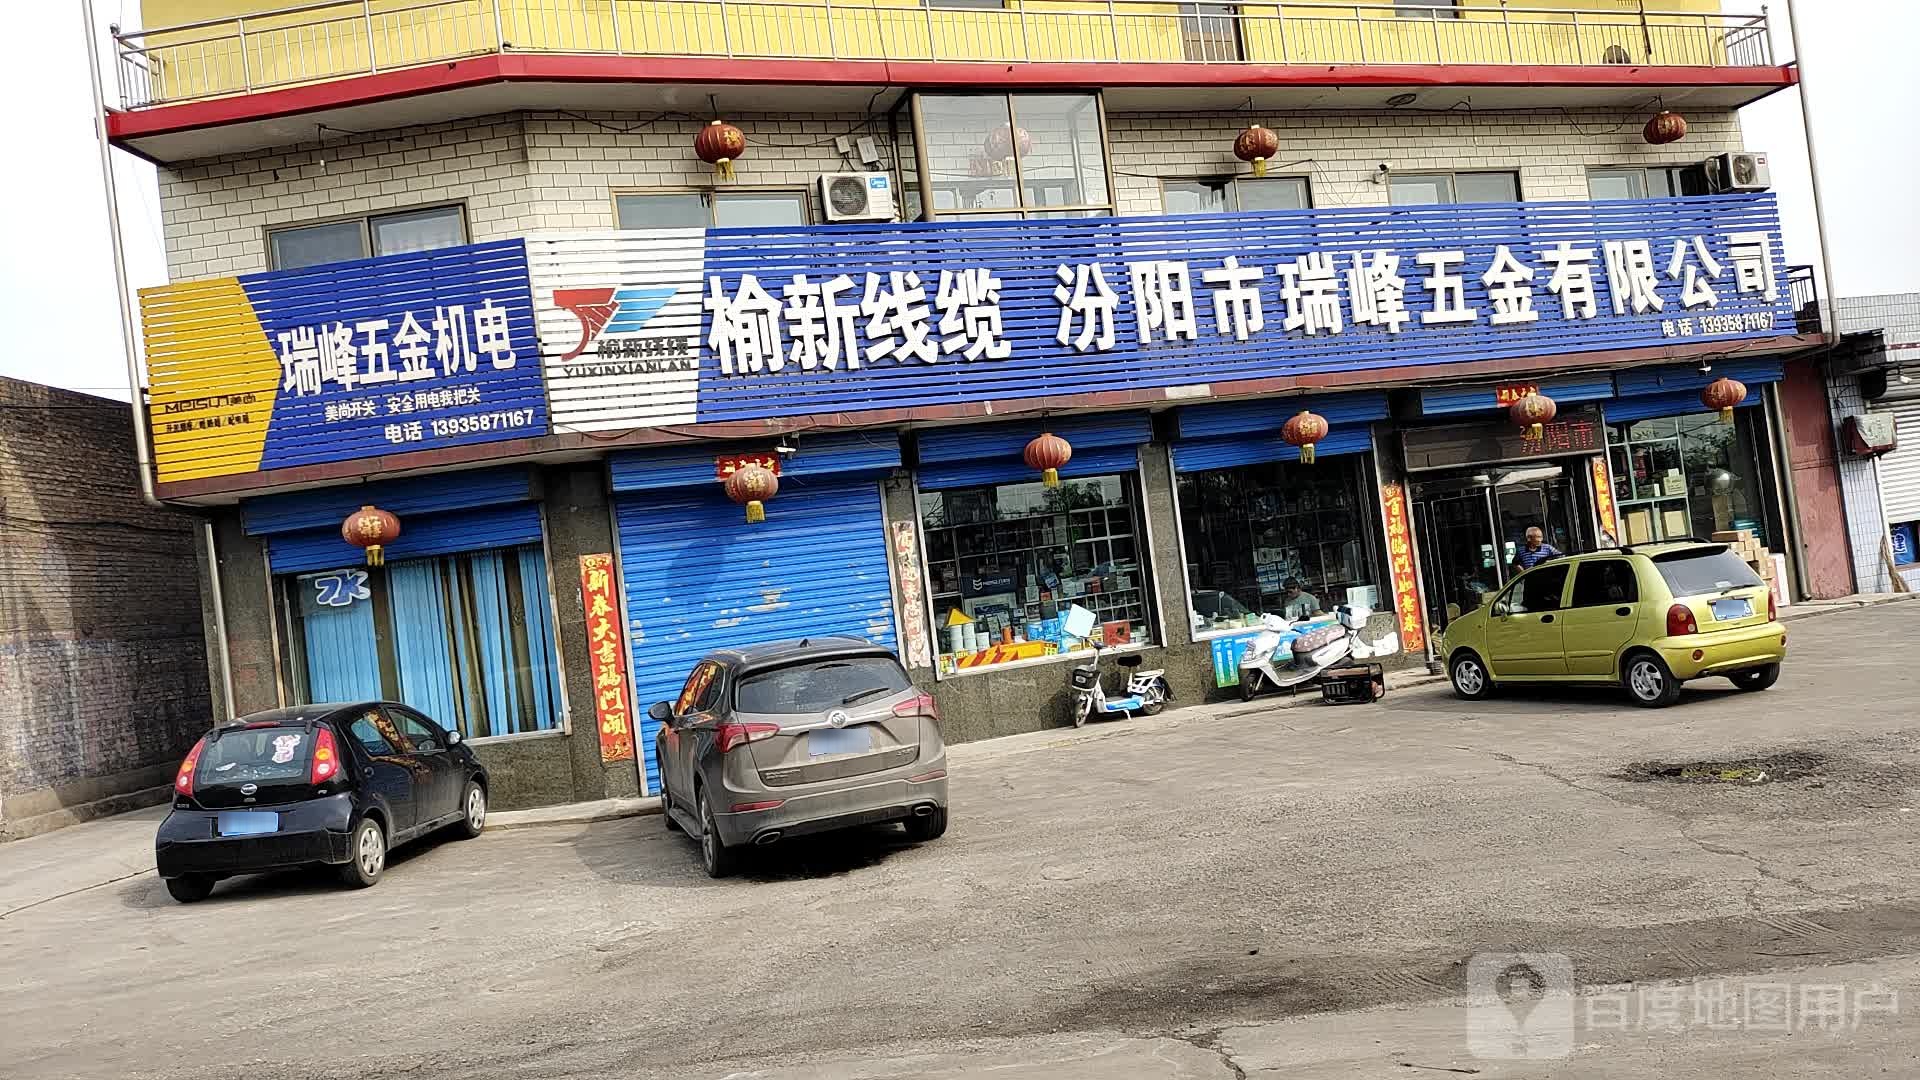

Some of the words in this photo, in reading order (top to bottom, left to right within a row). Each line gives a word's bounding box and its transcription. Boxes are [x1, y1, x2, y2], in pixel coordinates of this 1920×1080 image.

[705, 268, 1012, 375] 榆新线缆
[1054, 231, 1778, 351] 汾阳市瑞峰五金有限公司
[1661, 319, 1693, 337] 电话
[1699, 312, 1773, 333] 13935871167
[277, 298, 516, 398] 瑞峰五金机电
[563, 360, 691, 378] YUXINXIANLAN
[324, 400, 377, 422] 美尚开关
[387, 386, 481, 414] 安全用电我把关
[384, 421, 423, 444] 电话
[431, 409, 534, 437] 13935871167
